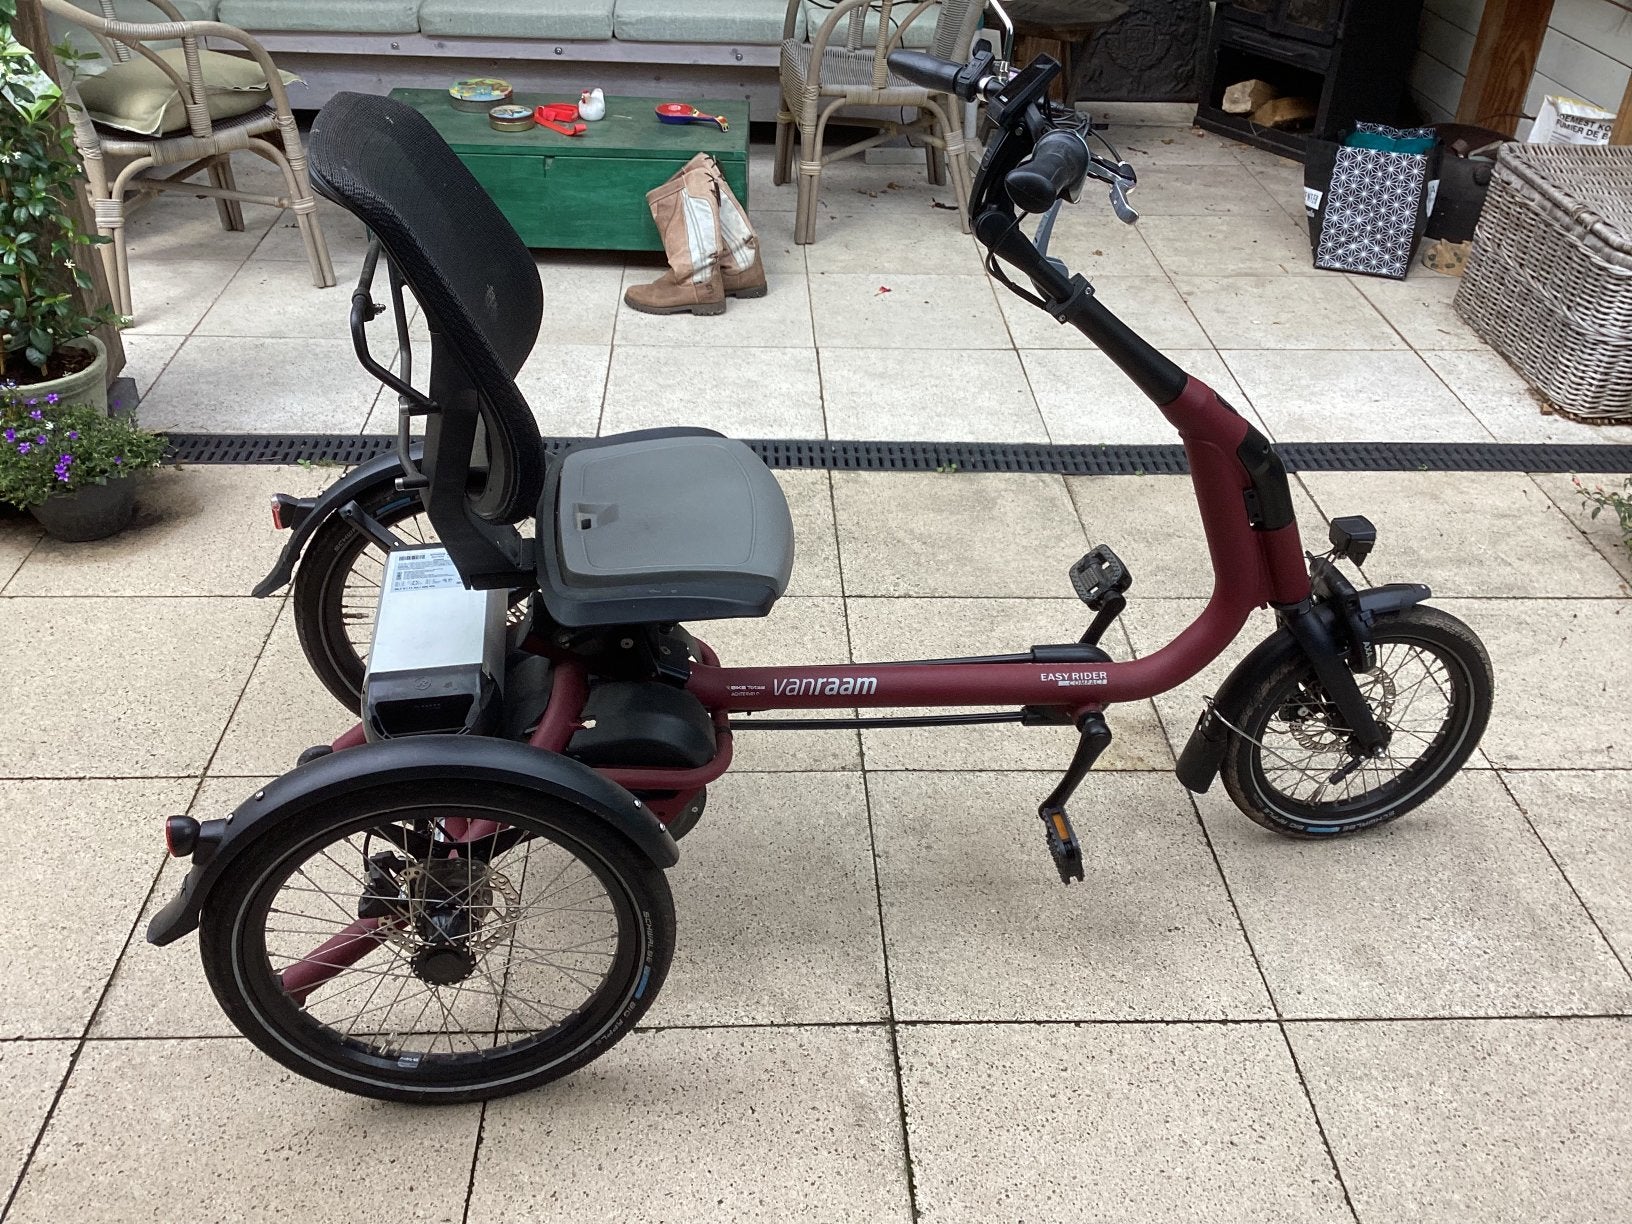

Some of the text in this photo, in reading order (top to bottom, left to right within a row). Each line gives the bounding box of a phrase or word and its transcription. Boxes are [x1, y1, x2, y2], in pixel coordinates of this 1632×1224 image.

[1556, 118, 1584, 134] FUMIER
[1586, 129, 1600, 138] DE
[1557, 113, 1597, 128] OEMEST
[773, 676, 878, 696] vanraam
[1040, 671, 1107, 681] EASY RIDER
[643, 910, 654, 963] SCHWALBE
